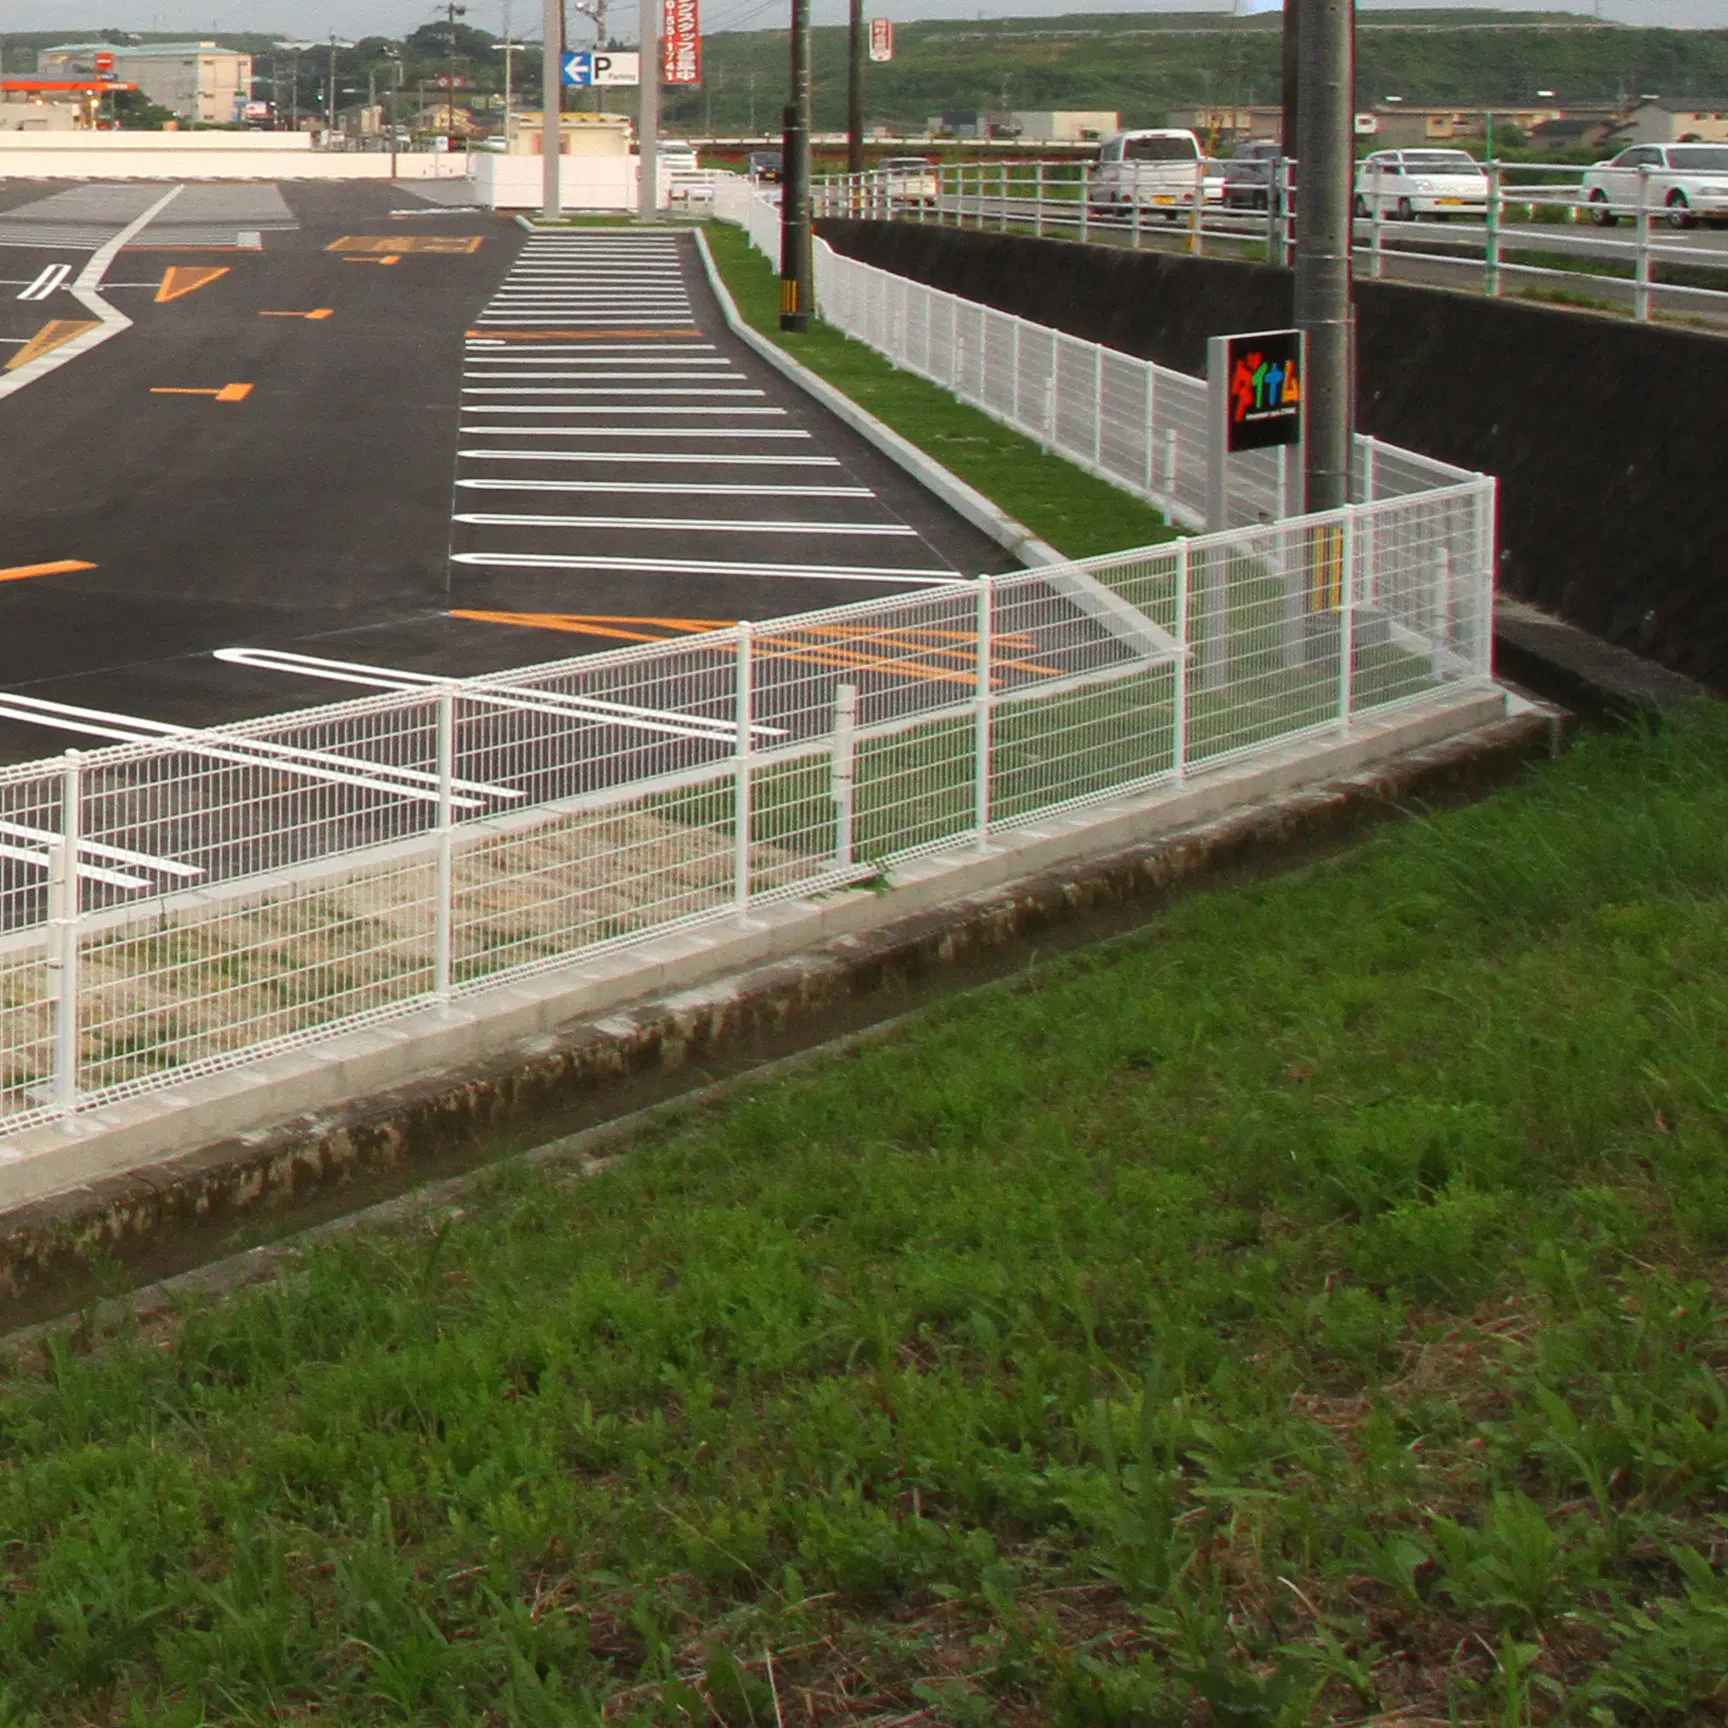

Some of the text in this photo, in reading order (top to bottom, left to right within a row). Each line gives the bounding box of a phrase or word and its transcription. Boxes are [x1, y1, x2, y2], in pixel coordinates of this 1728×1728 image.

[594, 57, 611, 79] P
[1232, 352, 1301, 423] ダイナム
